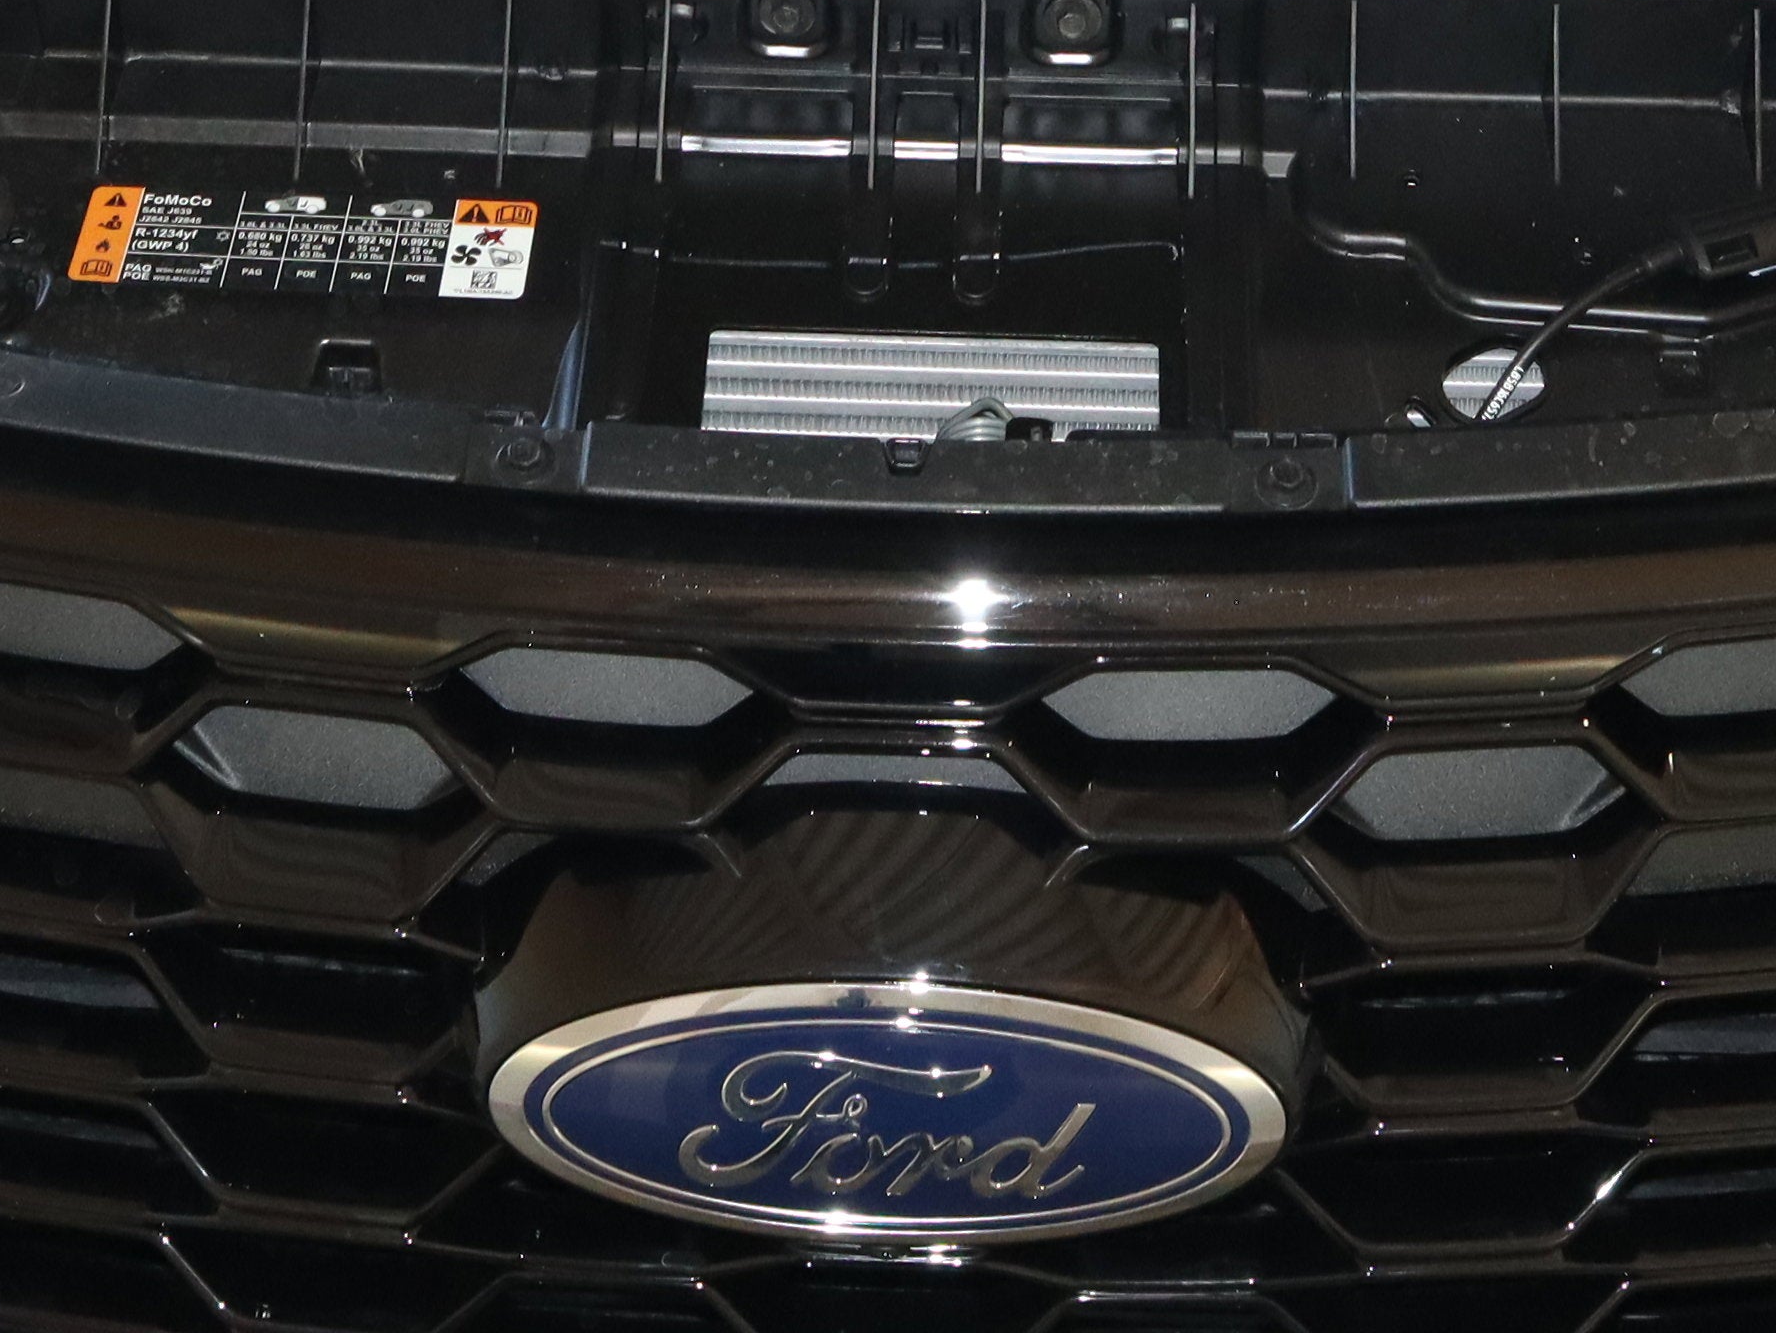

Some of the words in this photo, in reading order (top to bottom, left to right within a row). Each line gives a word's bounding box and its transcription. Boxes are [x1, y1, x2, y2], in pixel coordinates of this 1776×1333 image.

[143, 194, 212, 207] FoMoCo
[166, 207, 193, 216] J639
[135, 227, 198, 241] R-1234yf
[268, 233, 283, 243] kg
[291, 234, 320, 243] 0.737
[321, 235, 336, 245] kg
[348, 235, 377, 244] 0.992
[378, 236, 393, 246] kg
[401, 237, 430, 246] 0.992
[431, 238, 446, 249] kg
[131, 239, 172, 252] (GWP
[174, 241, 190, 253] 4)
[259, 249, 274, 257] lbs
[293, 250, 311, 258] 1.63
[348, 252, 368, 260] 2.19
[370, 252, 384, 260] lbs
[124, 263, 152, 272] PAG
[241, 267, 263, 276] PAG
[122, 271, 151, 281] POE
[296, 270, 317, 278] POE
[350, 272, 372, 280] PAG
[405, 274, 426, 283] POE
[678, 1049, 1096, 1199] Ford
